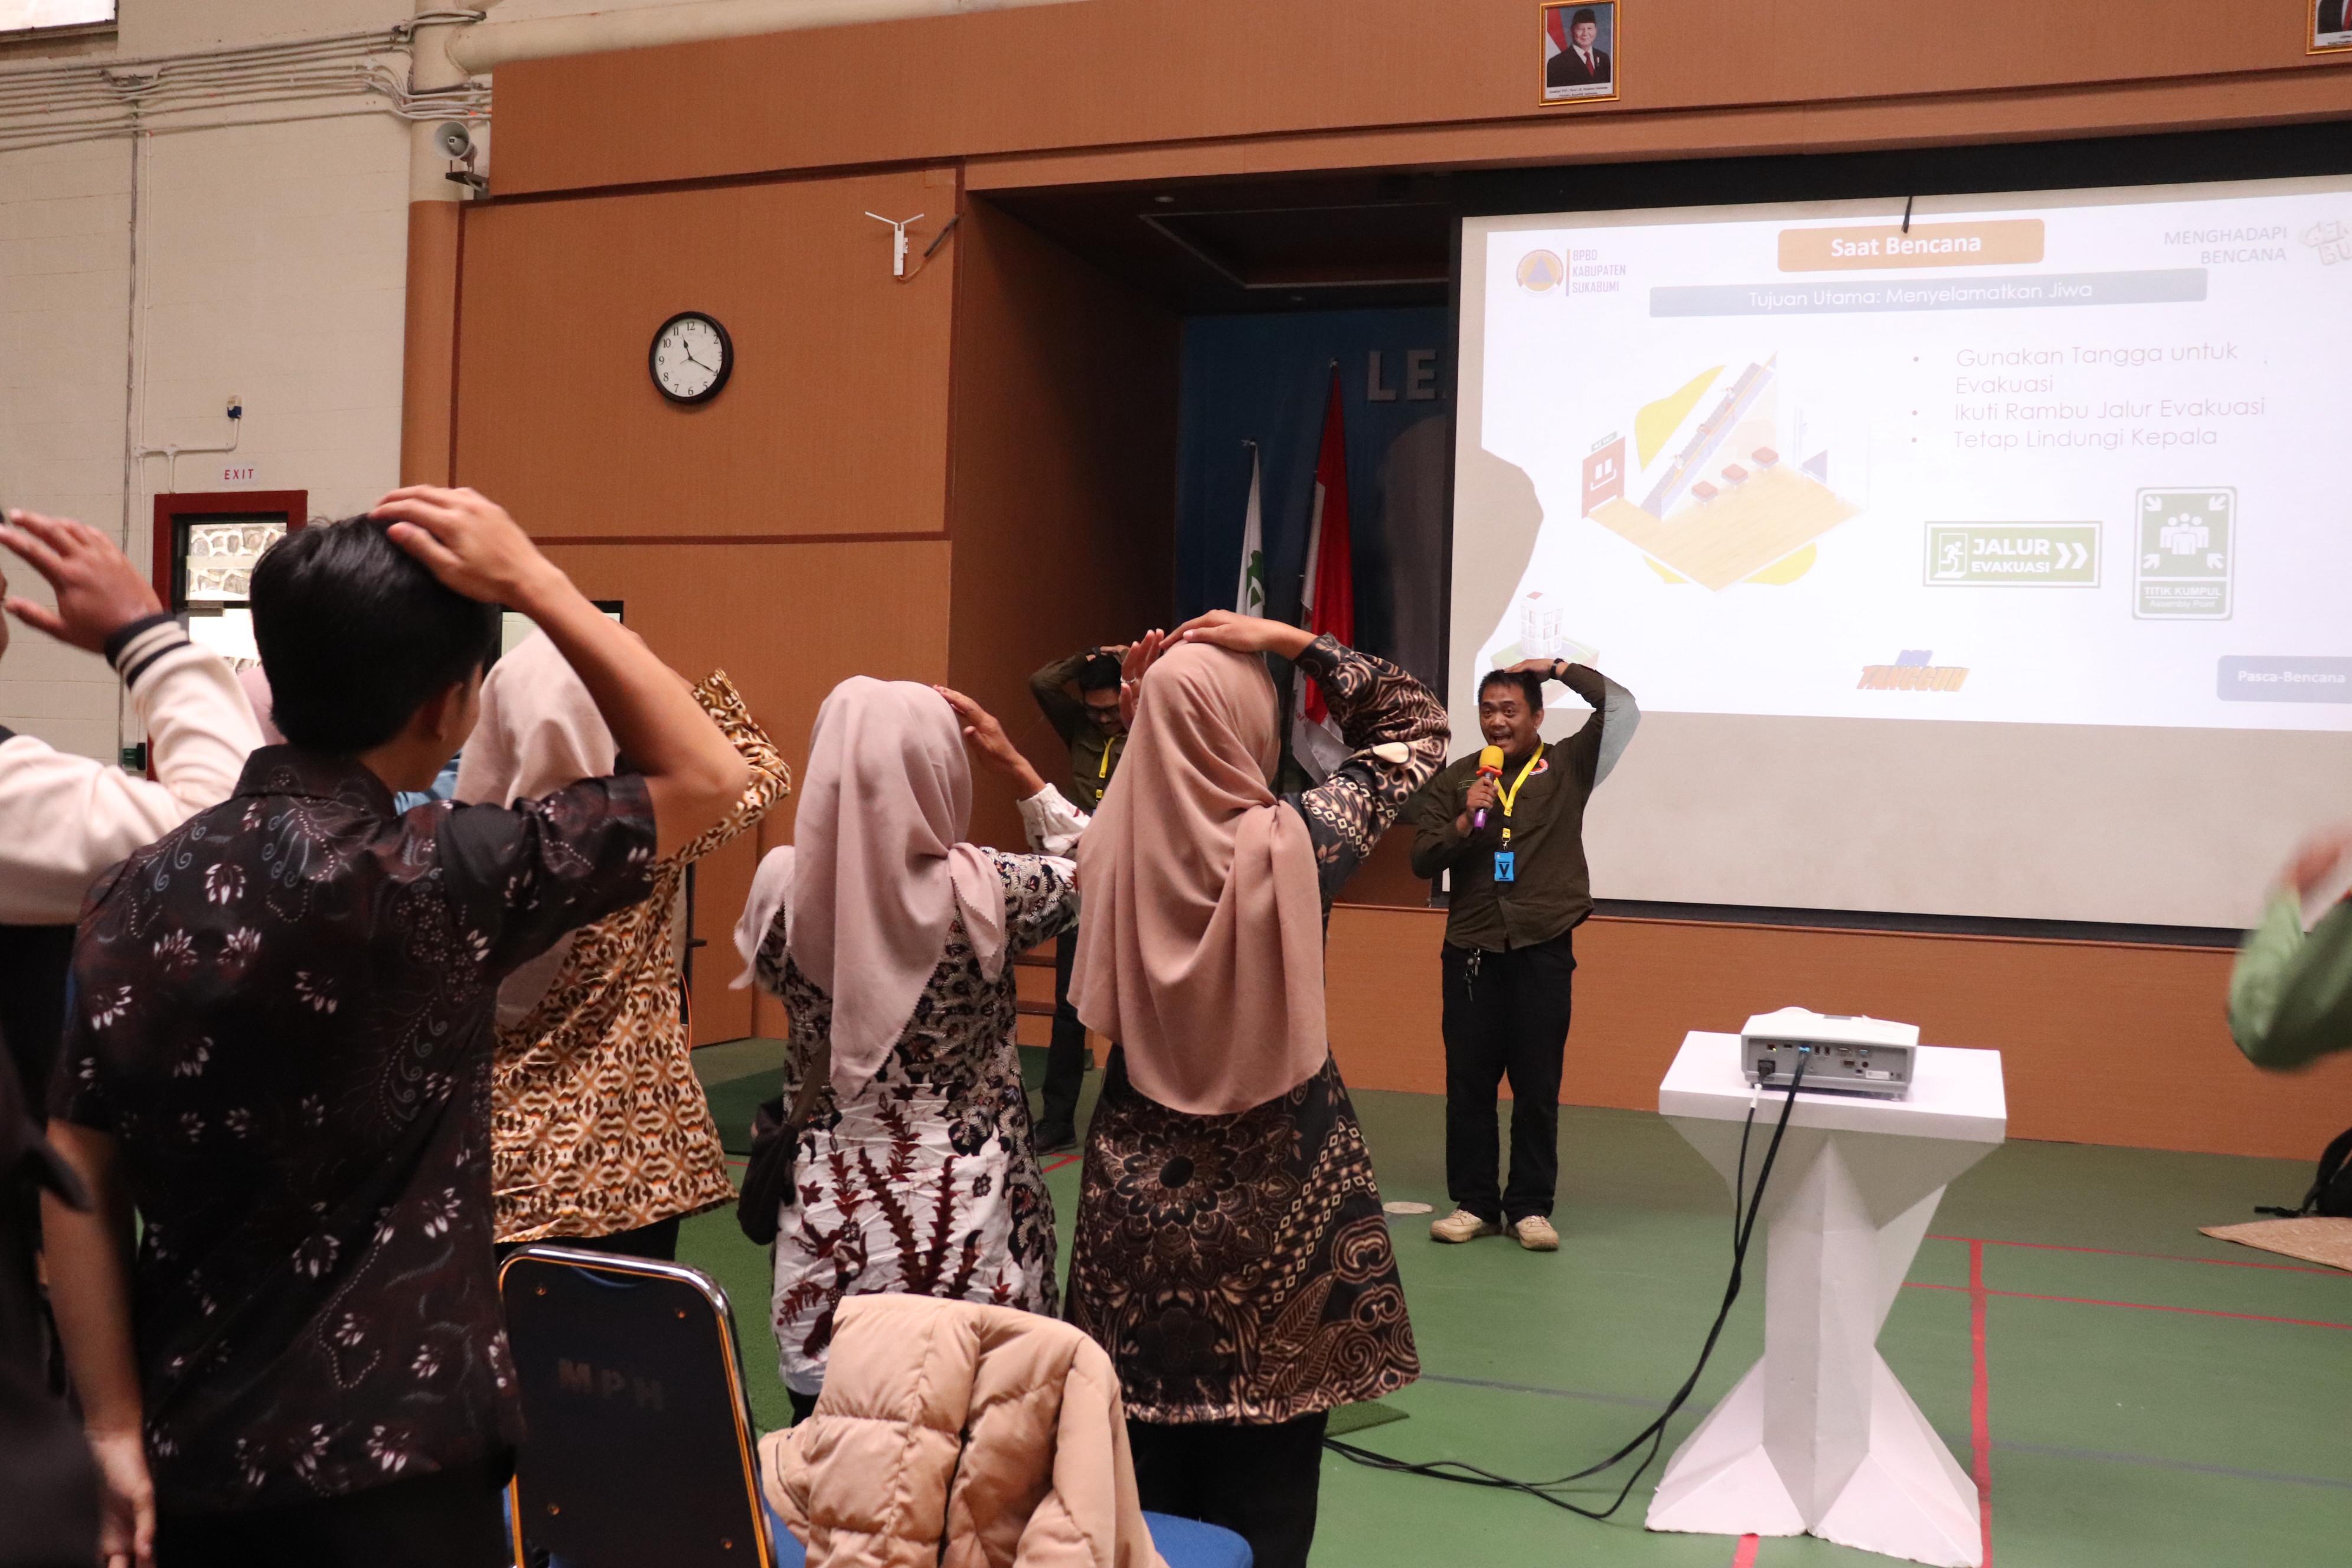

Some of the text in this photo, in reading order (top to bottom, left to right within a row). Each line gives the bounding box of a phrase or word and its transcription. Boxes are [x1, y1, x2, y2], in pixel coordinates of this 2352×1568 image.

[2164, 226, 2288, 245] MENGHADAPI
[1831, 236, 1981, 257] Saat Bencana
[1573, 249, 1598, 262] BPBD
[2201, 247, 2287, 264] BENCANA
[1573, 264, 1626, 277] KABUPATEN
[1572, 281, 1619, 293] SUKABUMI
[1749, 282, 2093, 310] Tujuan Utama: Menyelamatkan Jiwa
[674, 327, 679, 335] 11
[687, 321, 695, 331] 12
[704, 324, 707, 334] 1
[663, 338, 671, 348] 10
[713, 334, 719, 344] 2
[658, 356, 665, 365] 9
[1956, 341, 2238, 367] Gunakan Tangga untuk
[663, 373, 669, 382] 8
[1367, 348, 1446, 401] LE
[674, 384, 680, 393] 7
[703, 381, 709, 391] 5
[1956, 374, 2053, 394] Evakuasi
[688, 386, 694, 396] 6
[1955, 396, 2265, 420] Ikuti Rambu Jalur Evakuasi
[1954, 427, 2217, 452] Tetap Lindungi Kepala
[225, 469, 254, 479] EXIT
[1972, 538, 2050, 556] JALUR
[1971, 560, 2050, 573] EVAKUASI
[2144, 587, 2222, 596] TITIK KUMPUL
[2237, 669, 2346, 684] Pasca-Bencana
